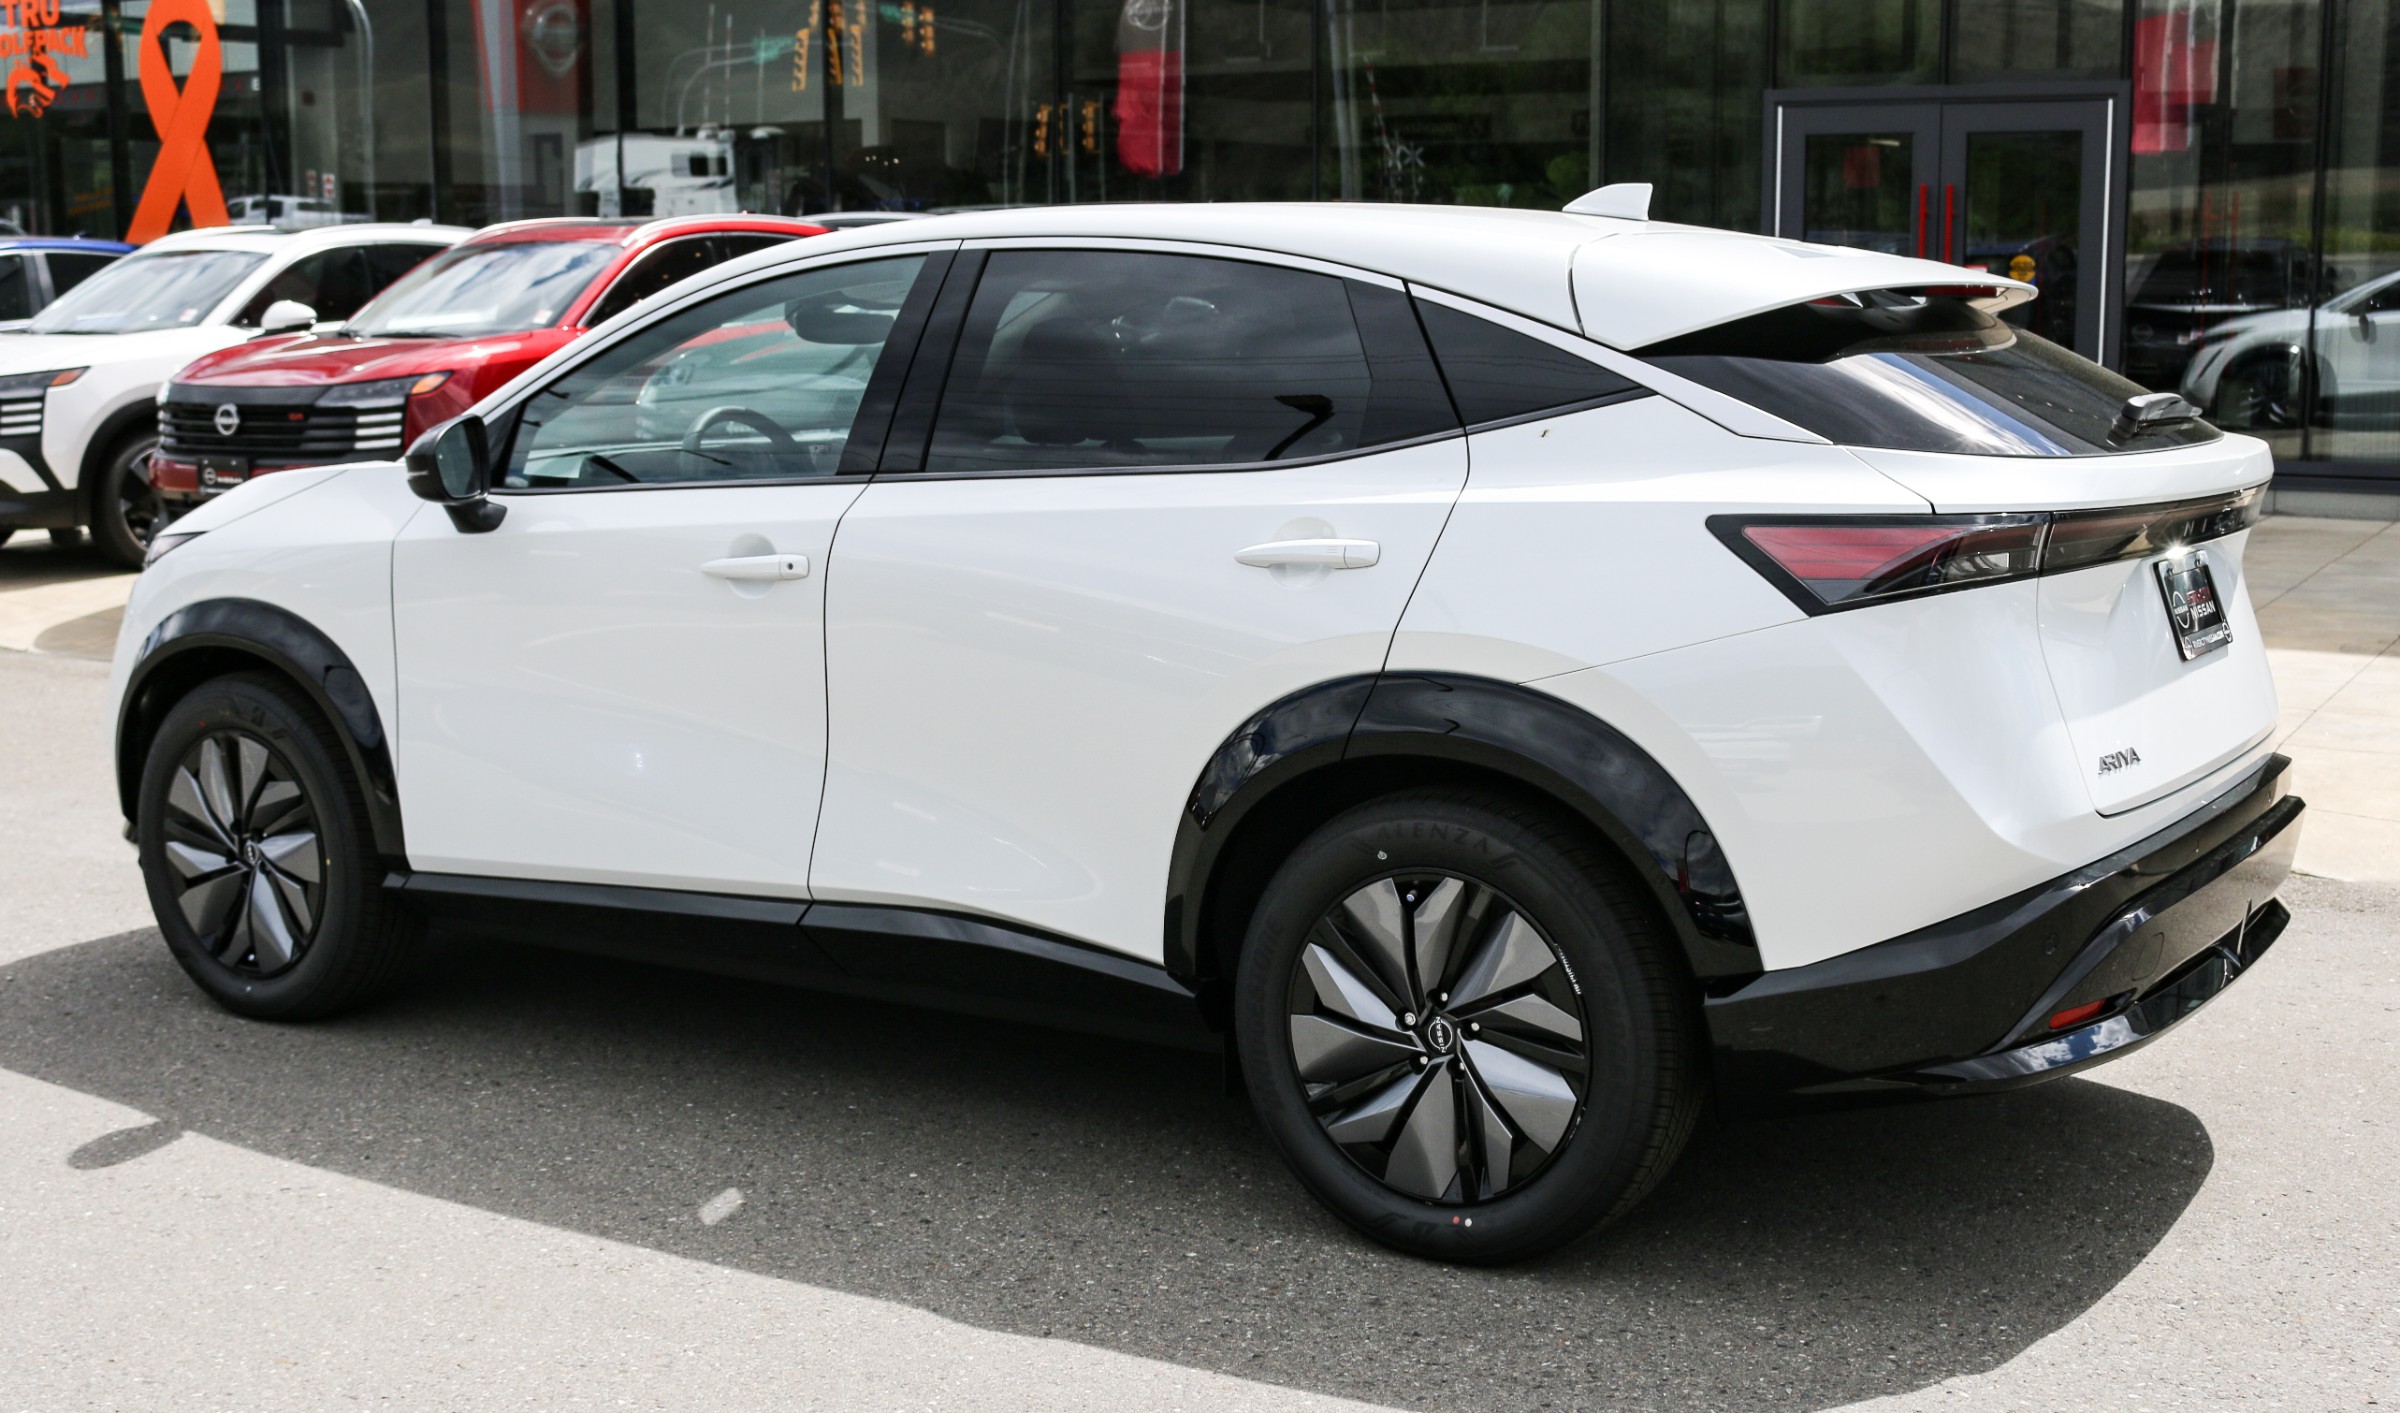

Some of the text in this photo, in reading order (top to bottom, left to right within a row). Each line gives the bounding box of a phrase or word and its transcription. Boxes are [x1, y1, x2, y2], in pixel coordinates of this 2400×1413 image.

[0, 0, 60, 29] TRU
[0, 26, 88, 59] OLFPACK
[2190, 600, 2216, 620] NISSAN
[2098, 747, 2141, 775] ARIYA
[1376, 821, 1490, 853] ALENZA
[1435, 1016, 1447, 1053] NISSAN
